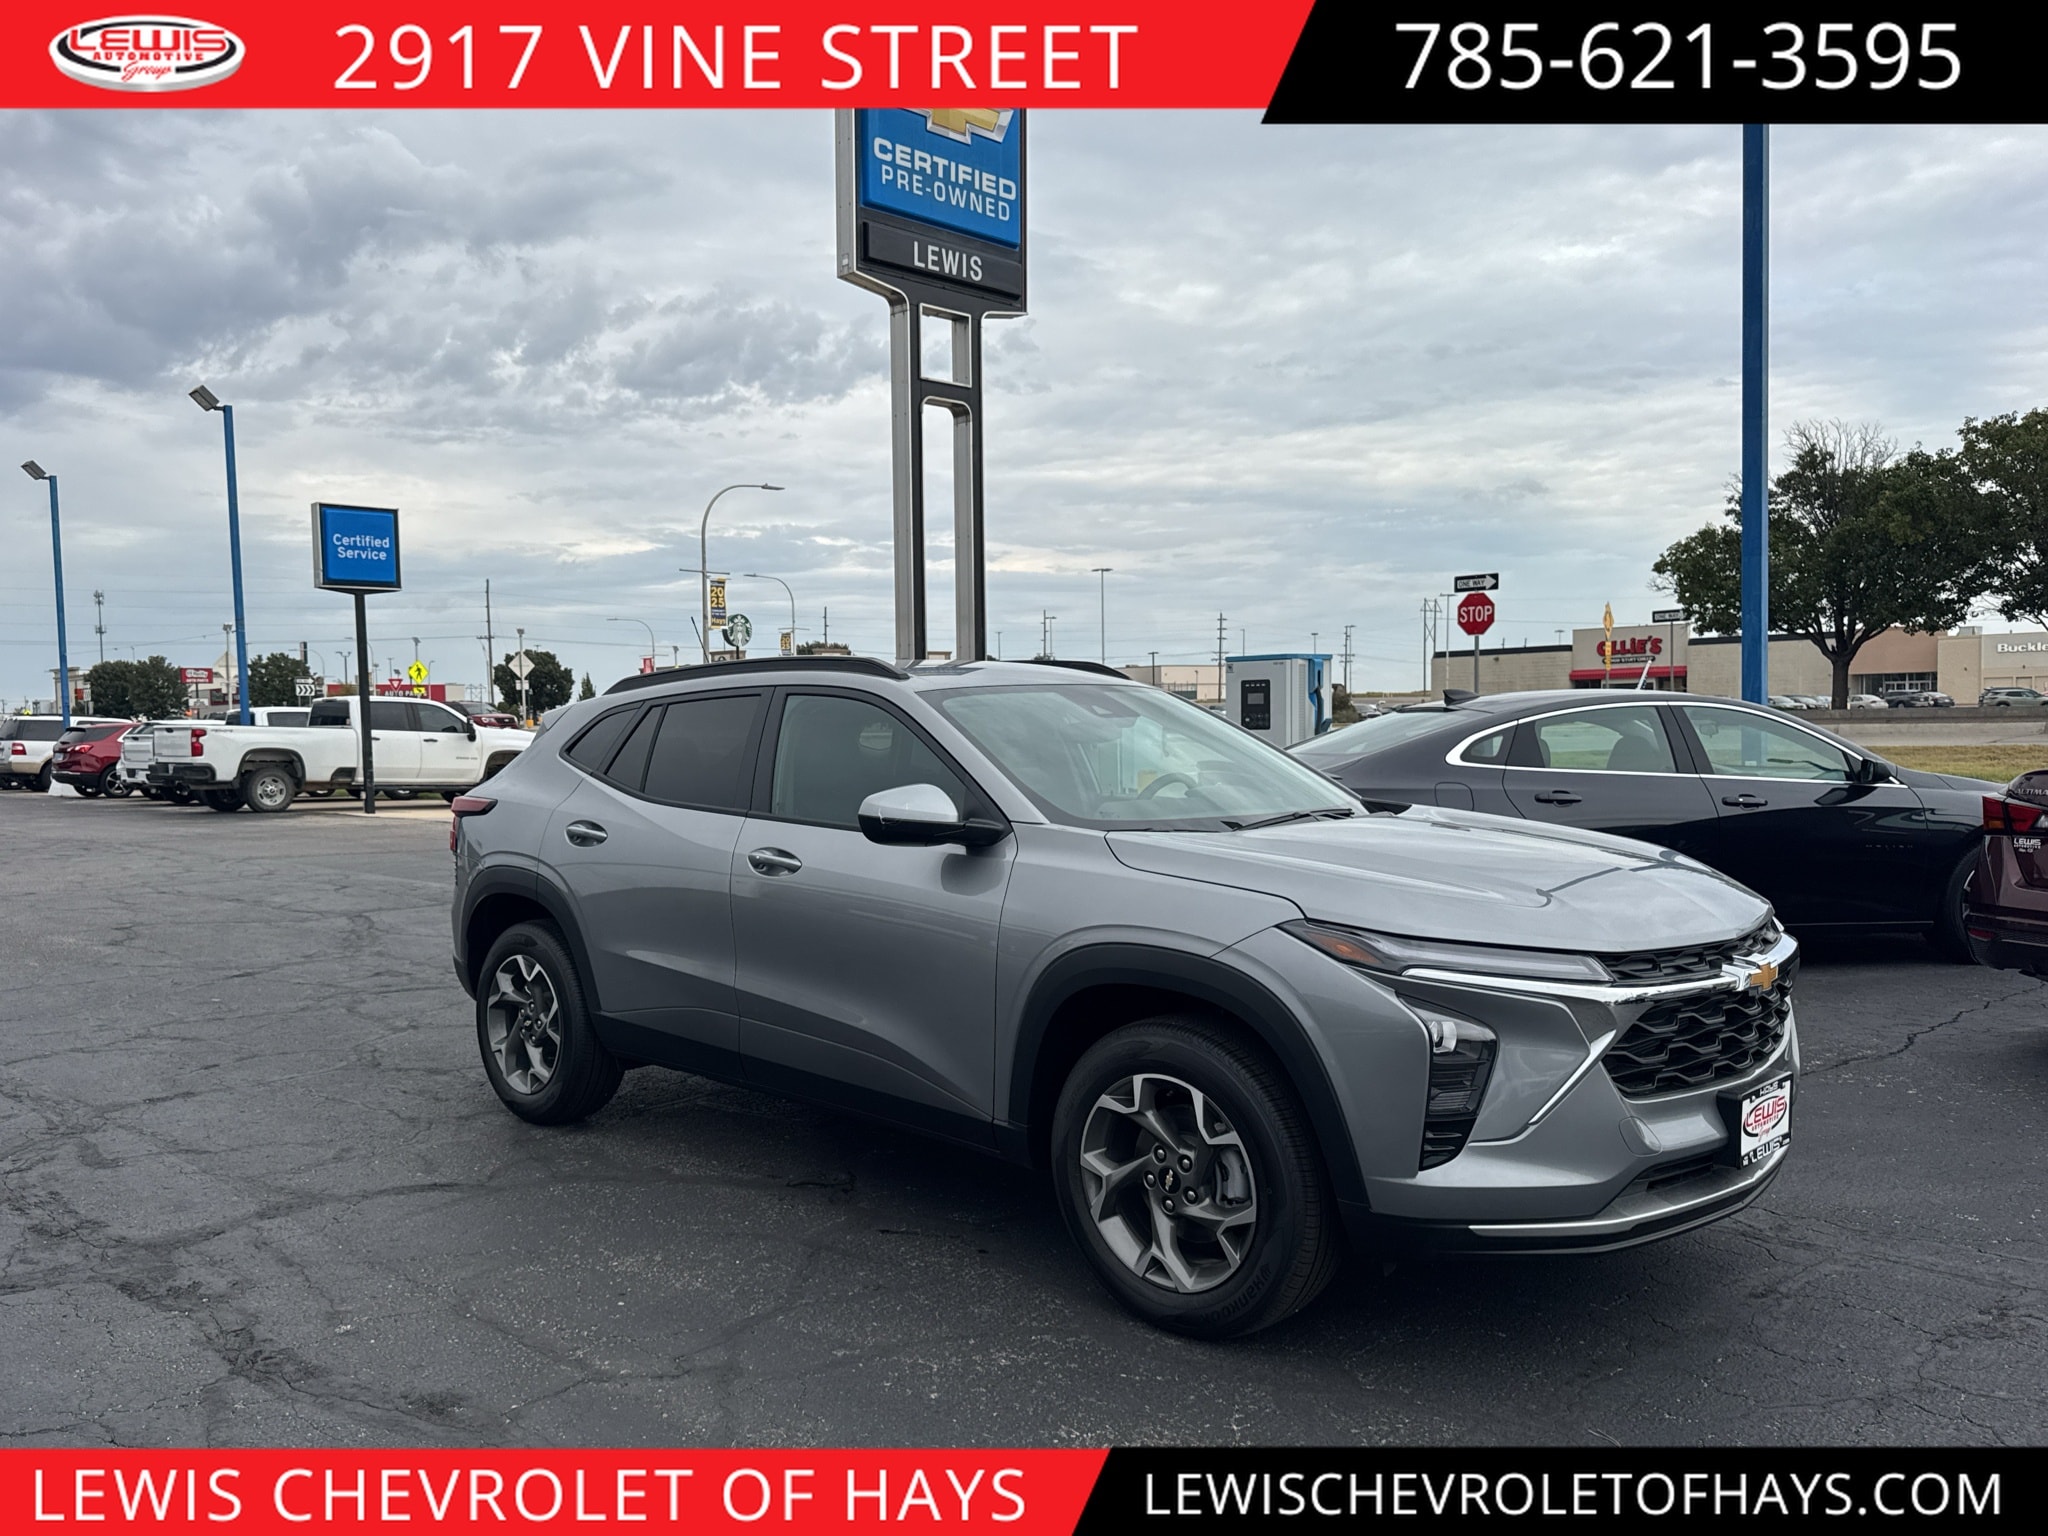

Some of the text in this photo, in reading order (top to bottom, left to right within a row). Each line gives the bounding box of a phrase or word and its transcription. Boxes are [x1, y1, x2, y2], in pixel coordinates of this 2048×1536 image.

[873, 137, 1017, 200] CERTIFIED
[881, 165, 1010, 221] PRE-OWNED
[913, 241, 983, 281] LEWIS
[332, 533, 390, 548] Certified
[337, 546, 387, 560] Service
[1459, 580, 1471, 588] ONE
[710, 587, 724, 597] 20
[711, 597, 725, 608] 25
[1459, 605, 1492, 623] STOP
[1997, 642, 2048, 653] Buckle
[385, 689, 403, 697] AUTO
[2013, 838, 2041, 846] LEWIS
[1745, 1096, 1785, 1127] LEWIS
[1750, 1136, 1781, 1163] LEWIS
